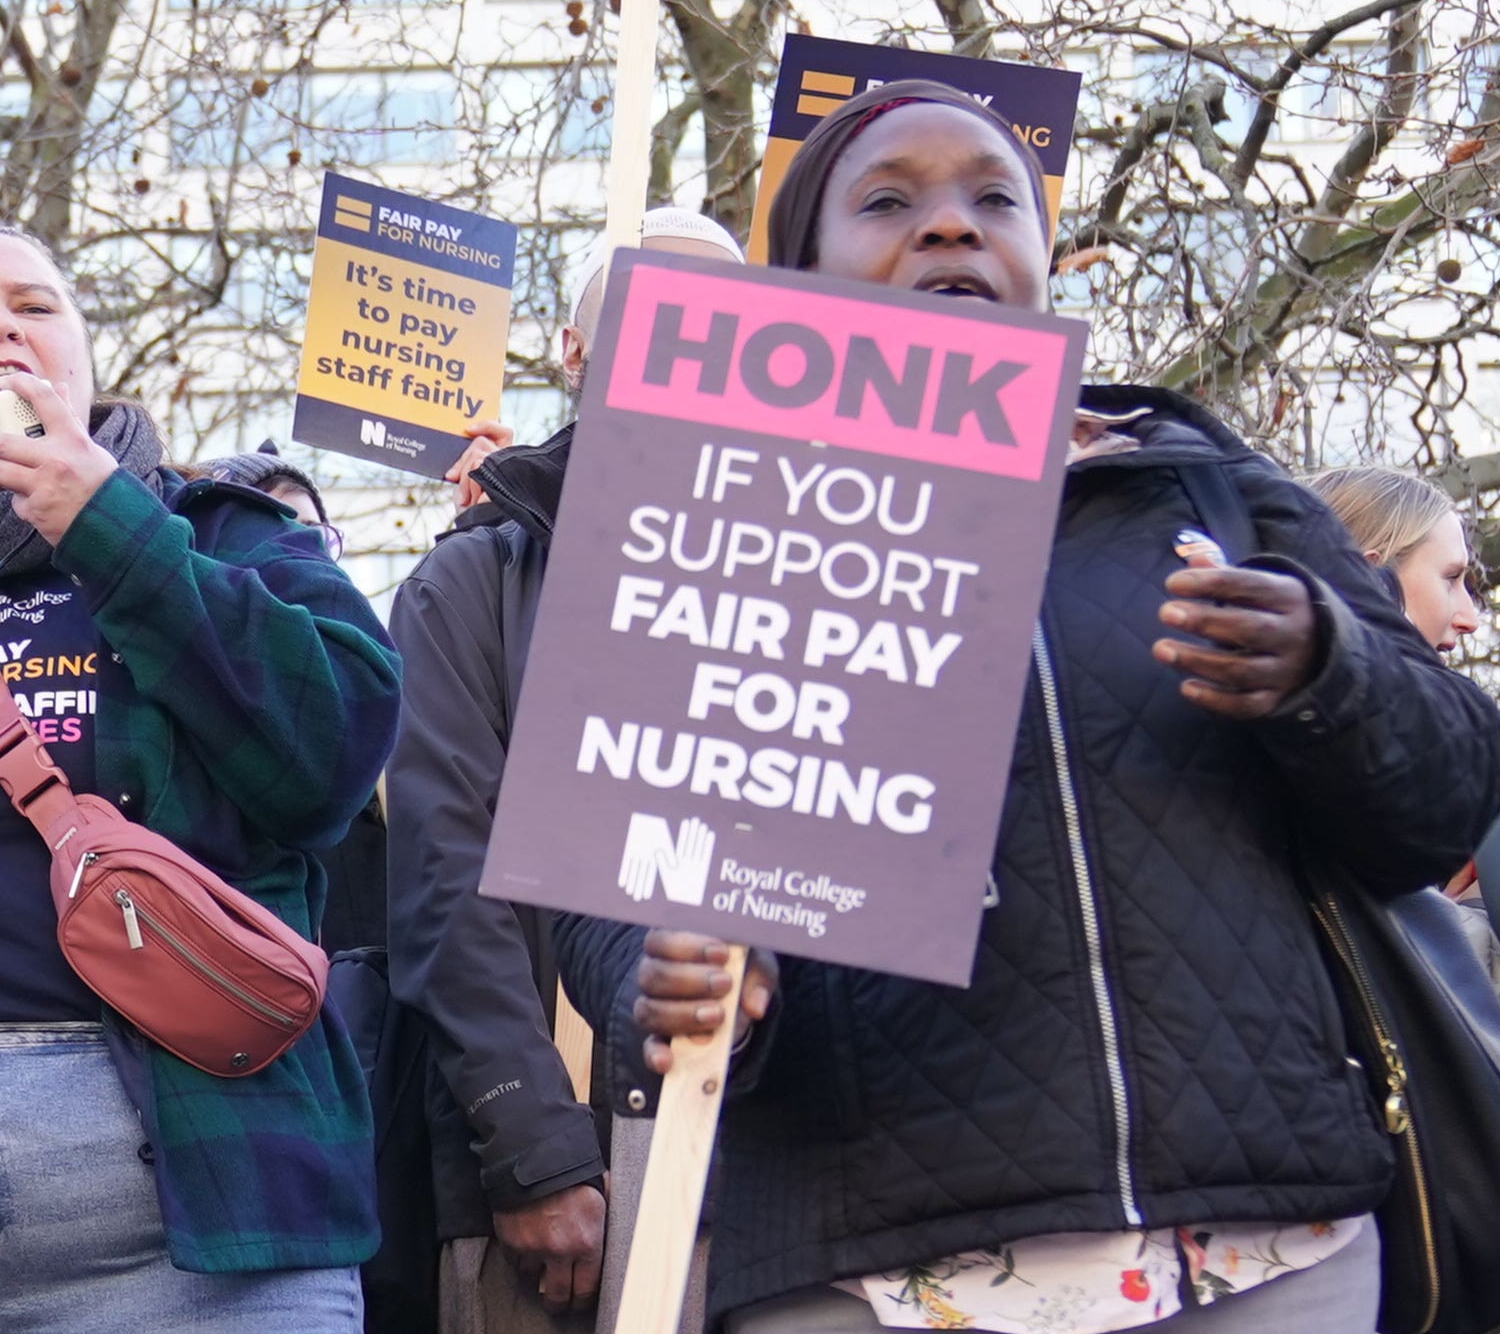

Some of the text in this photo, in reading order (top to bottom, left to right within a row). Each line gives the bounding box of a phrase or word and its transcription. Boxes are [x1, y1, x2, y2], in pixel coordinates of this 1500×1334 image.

[377, 222, 501, 269] FOR NURSING
[378, 206, 462, 242] FAIR PAY
[345, 261, 477, 315] It's time
[357, 298, 458, 347] to pay
[341, 329, 466, 382] nursing
[641, 302, 1032, 448] HONK
[316, 356, 485, 418] staff fairly
[692, 443, 933, 536] IF YOU
[621, 505, 980, 617] SUPPORT
[13, 591, 73, 611] College
[610, 575, 963, 688] FAIR PAY
[687, 661, 851, 746] FOR
[576, 715, 936, 835] NURSING
[712, 887, 827, 939] of Nursing
[719, 858, 866, 914] Royal College
